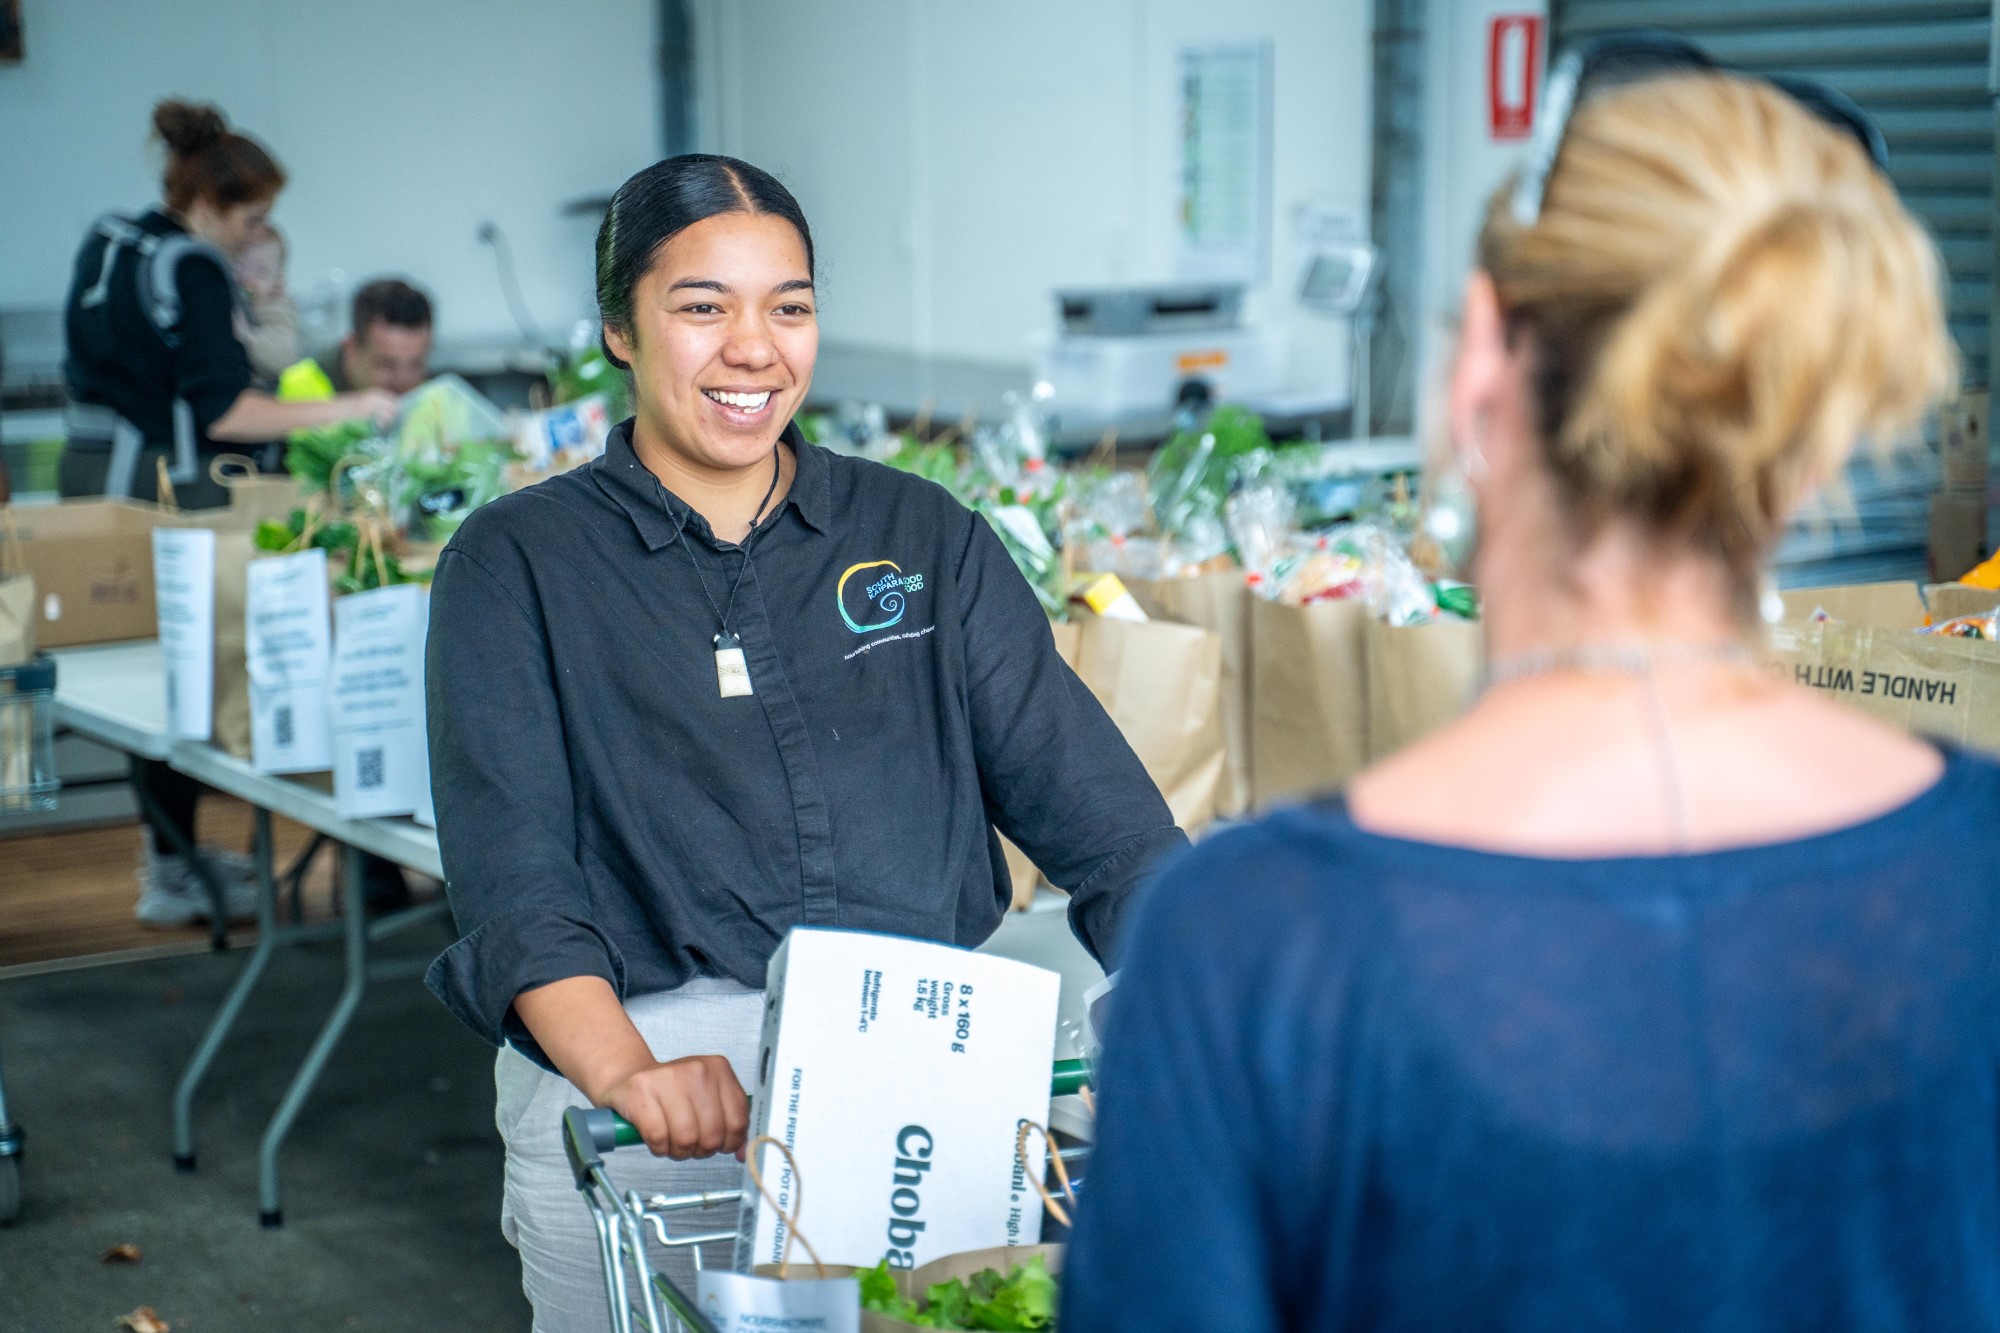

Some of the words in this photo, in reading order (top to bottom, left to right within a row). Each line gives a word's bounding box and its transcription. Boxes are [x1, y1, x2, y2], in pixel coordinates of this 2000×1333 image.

[866, 572, 895, 594] SOUTH
[868, 577, 904, 600] KAIPARA
[1795, 663, 1854, 691] WITH
[1861, 670, 1957, 705] HANDLE
[861, 970, 873, 1008] between
[870, 971, 883, 1021] Refrigerate
[917, 978, 928, 994] 1.5
[960, 984, 974, 996] 8
[913, 997, 928, 1012] kg
[926, 980, 941, 1019] weight
[941, 982, 954, 1016] Gross
[958, 998, 969, 1008] x
[955, 1012, 971, 1040] 160
[951, 1042, 966, 1054] g
[791, 1068, 803, 1090] FOR
[788, 1093, 800, 1115] THE
[784, 1117, 797, 1165] PERFET
[780, 1168, 792, 1190] POT
[778, 1192, 789, 1209] OF
[885, 1125, 934, 1271] Choba
[1007, 1207, 1022, 1237] High
[772, 1210, 787, 1264] HOBANI
